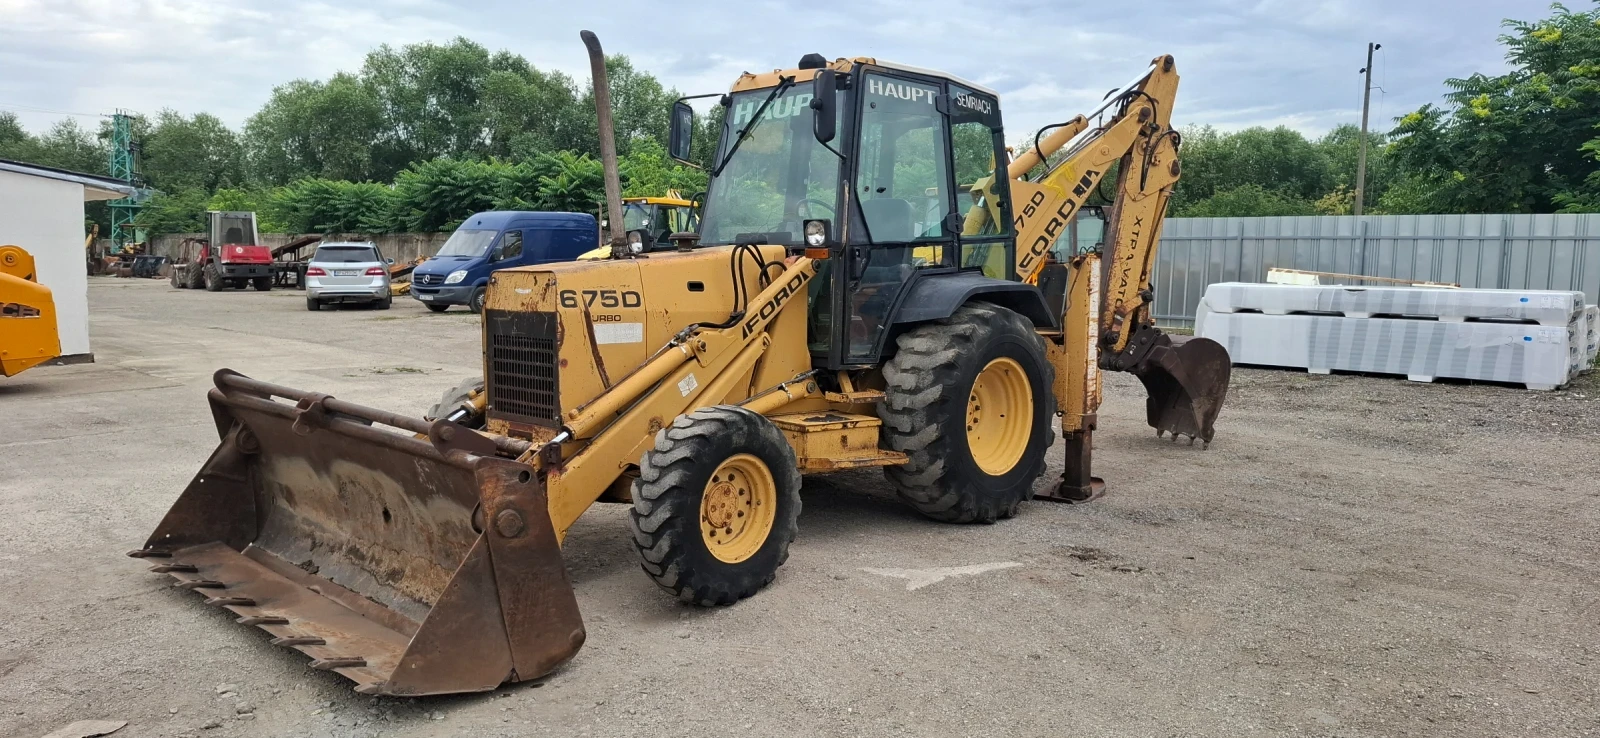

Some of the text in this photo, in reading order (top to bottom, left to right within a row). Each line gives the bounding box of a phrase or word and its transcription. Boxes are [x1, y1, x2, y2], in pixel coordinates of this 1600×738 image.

[869, 79, 936, 105] HAUPT
[734, 93, 813, 125] HAUP
[1014, 190, 1045, 237] 75D
[1018, 198, 1076, 269] FORD
[0, 301, 41, 318] CB
[559, 289, 642, 309] 675D
[744, 272, 803, 335] FORD
[591, 314, 622, 323] URBO
